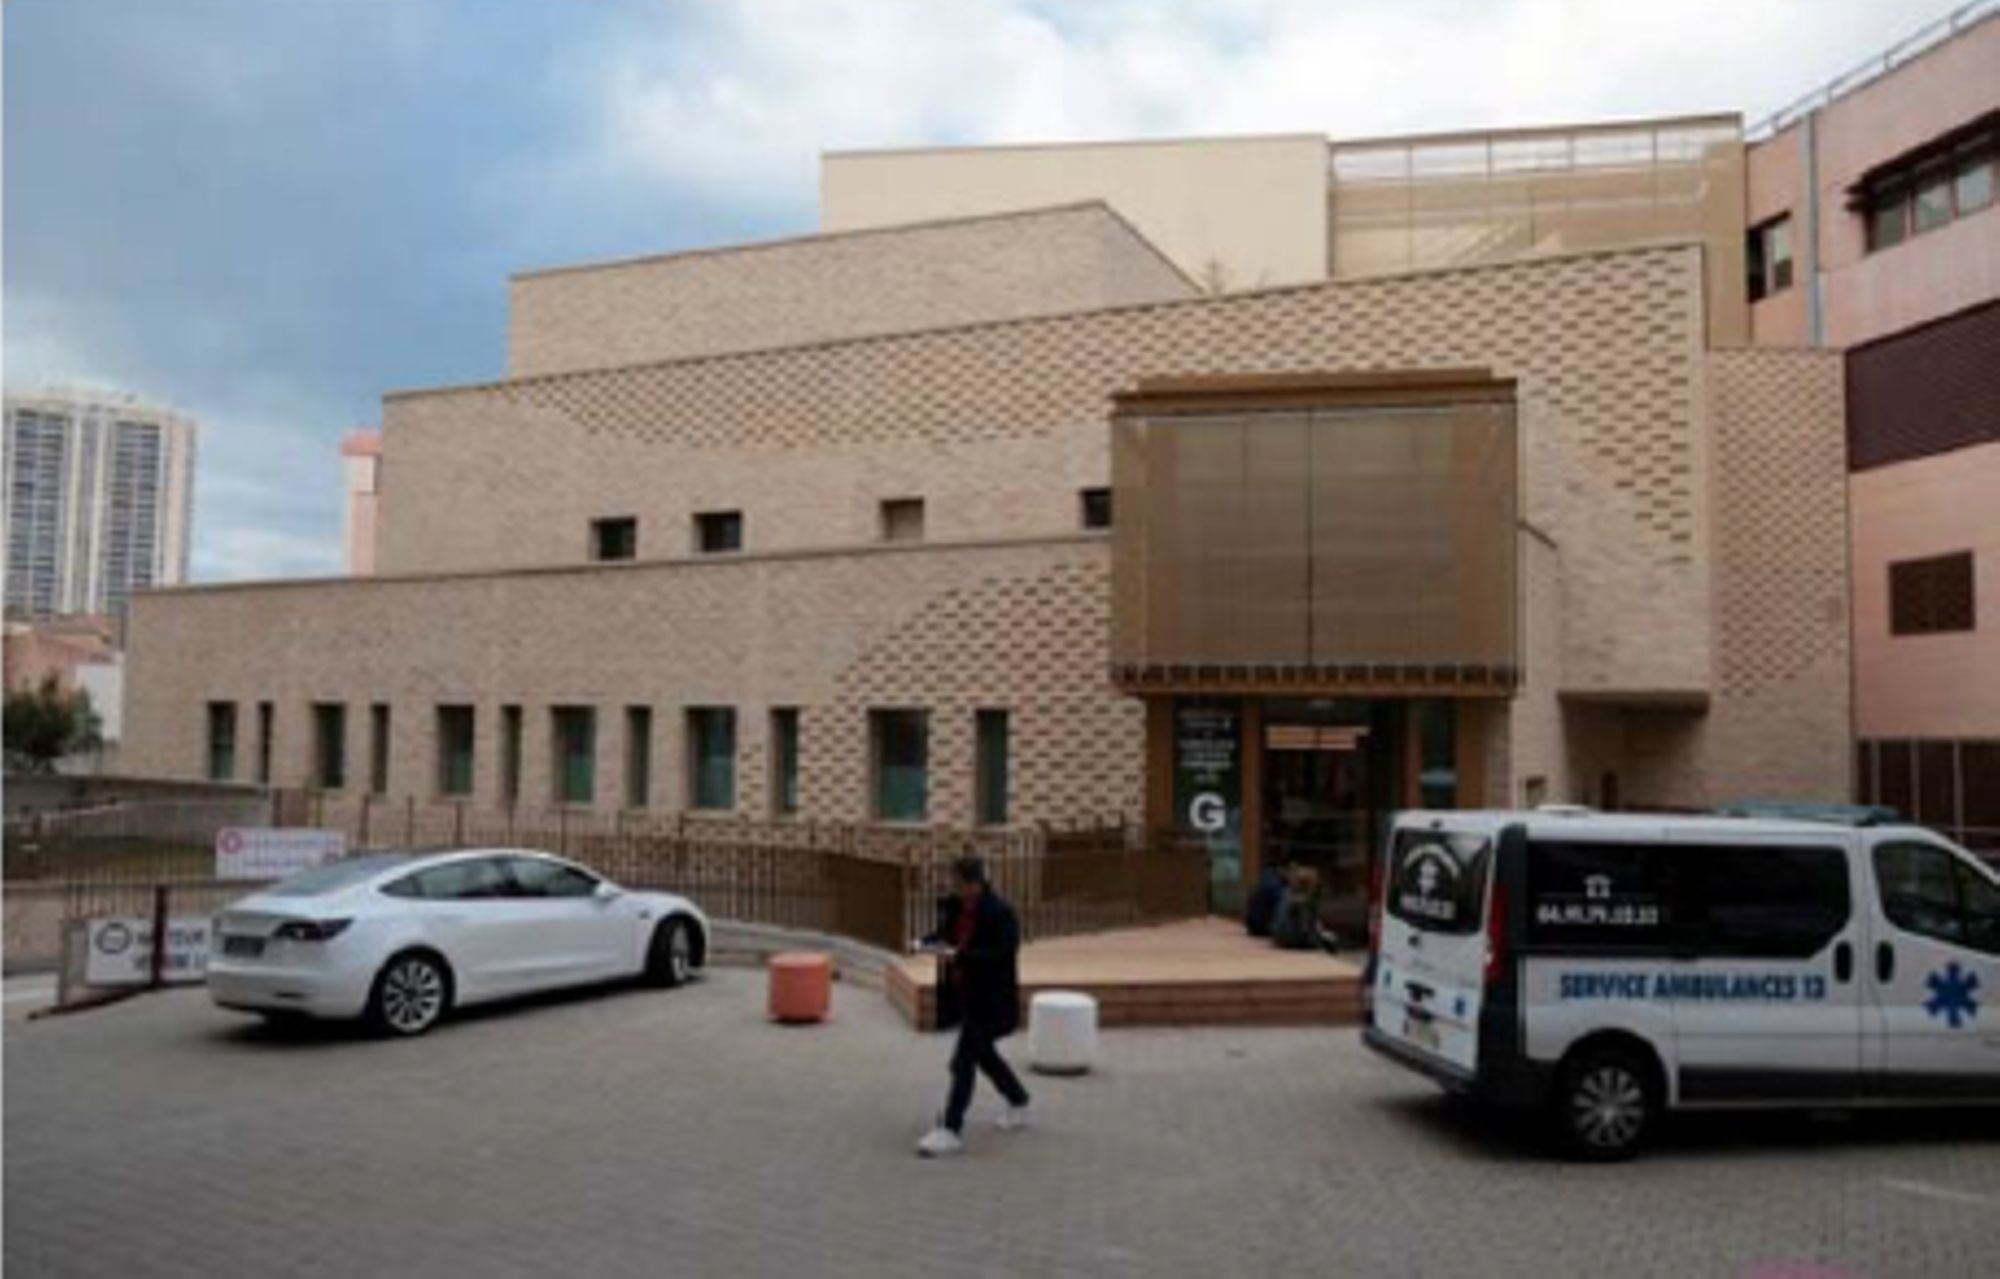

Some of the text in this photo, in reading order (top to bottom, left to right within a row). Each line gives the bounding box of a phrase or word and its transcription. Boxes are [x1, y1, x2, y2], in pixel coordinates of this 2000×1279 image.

[1189, 792, 1227, 831] G
[1560, 974, 1648, 999] SERVICE
[1652, 974, 1798, 1000] AMBULANCES
